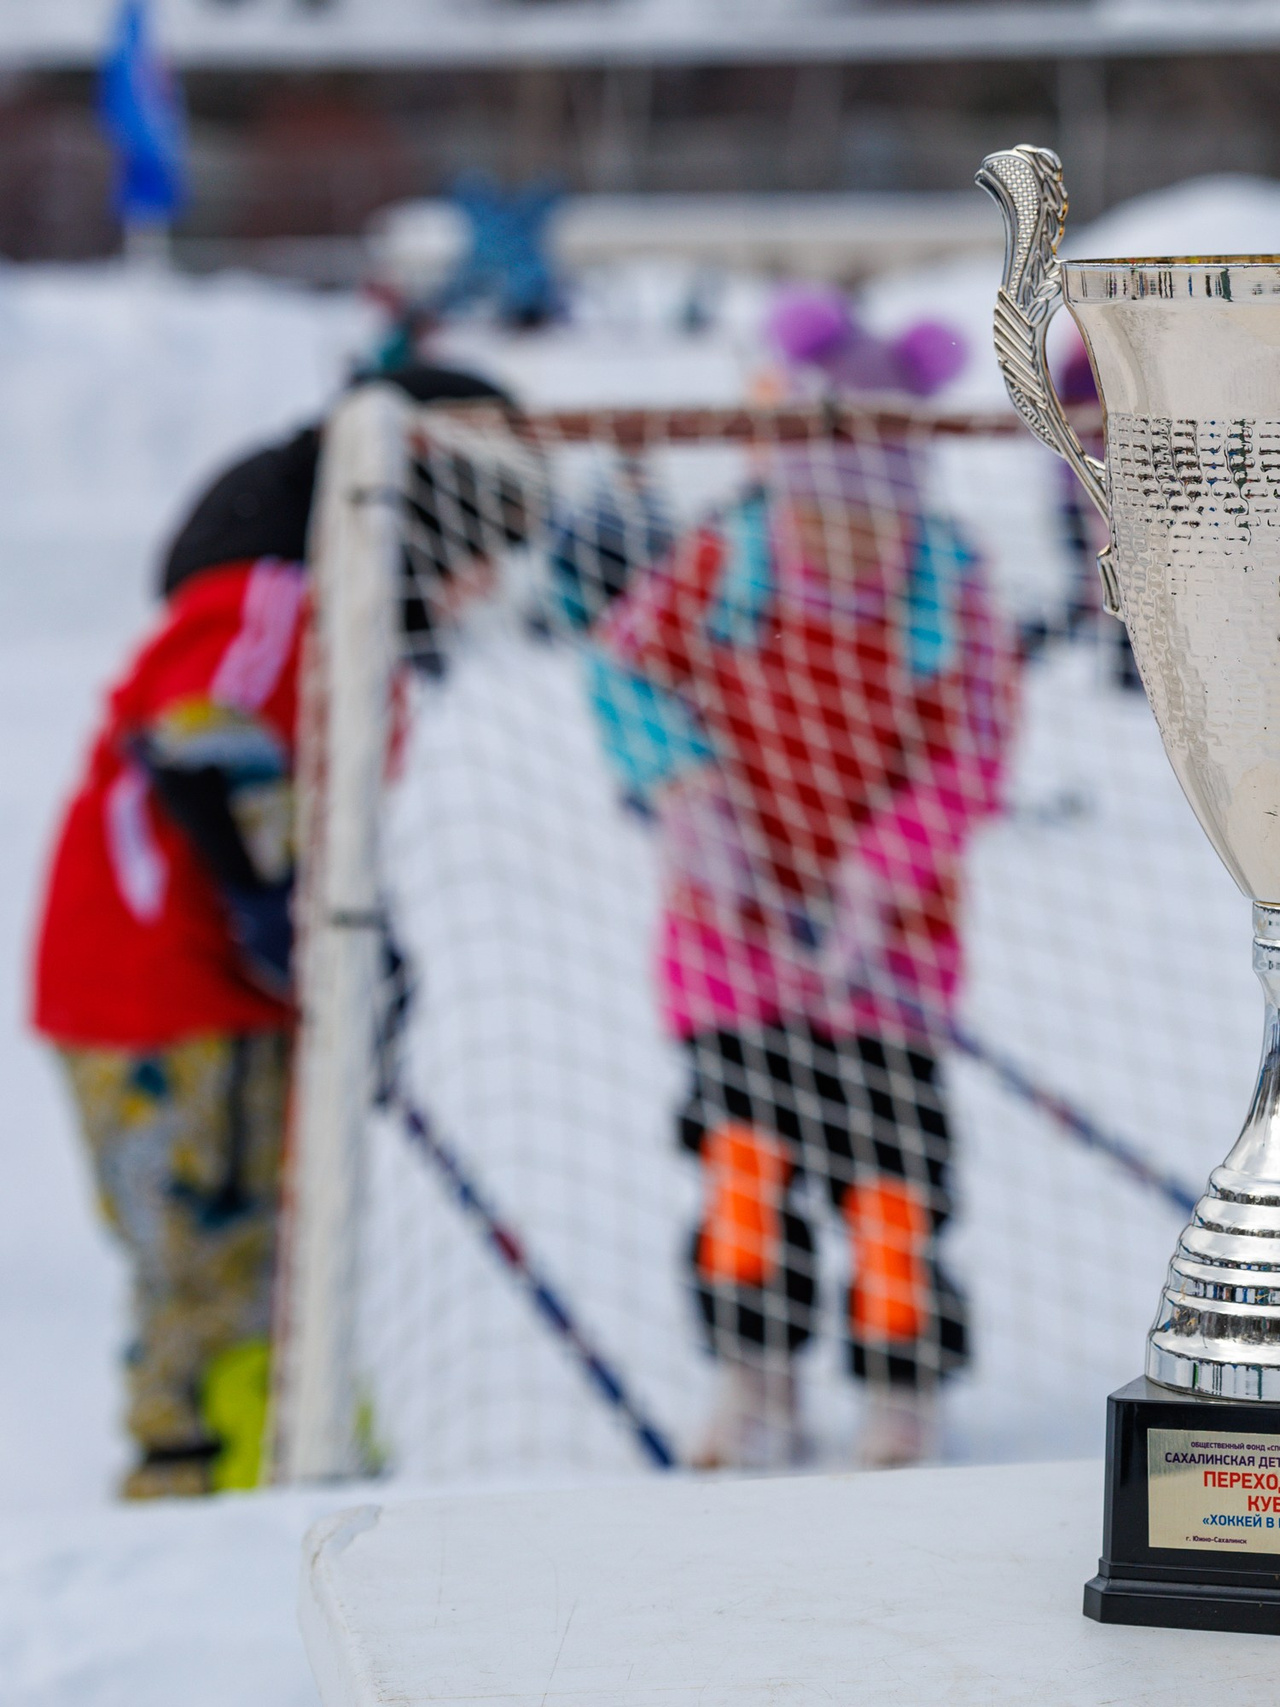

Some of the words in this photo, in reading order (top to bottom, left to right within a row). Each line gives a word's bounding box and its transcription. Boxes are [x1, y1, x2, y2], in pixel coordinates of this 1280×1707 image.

[1191, 1441, 1244, 1449] ОБЩЕСТВЕННЫЙ
[1165, 1452, 1255, 1466] САХАЛИНСКАЯ
[1203, 1513, 1261, 1528] «ХОККЕЙ
[1267, 1517, 1274, 1528] В
[1193, 1535, 1247, 1544] Южно-Сахалинск
